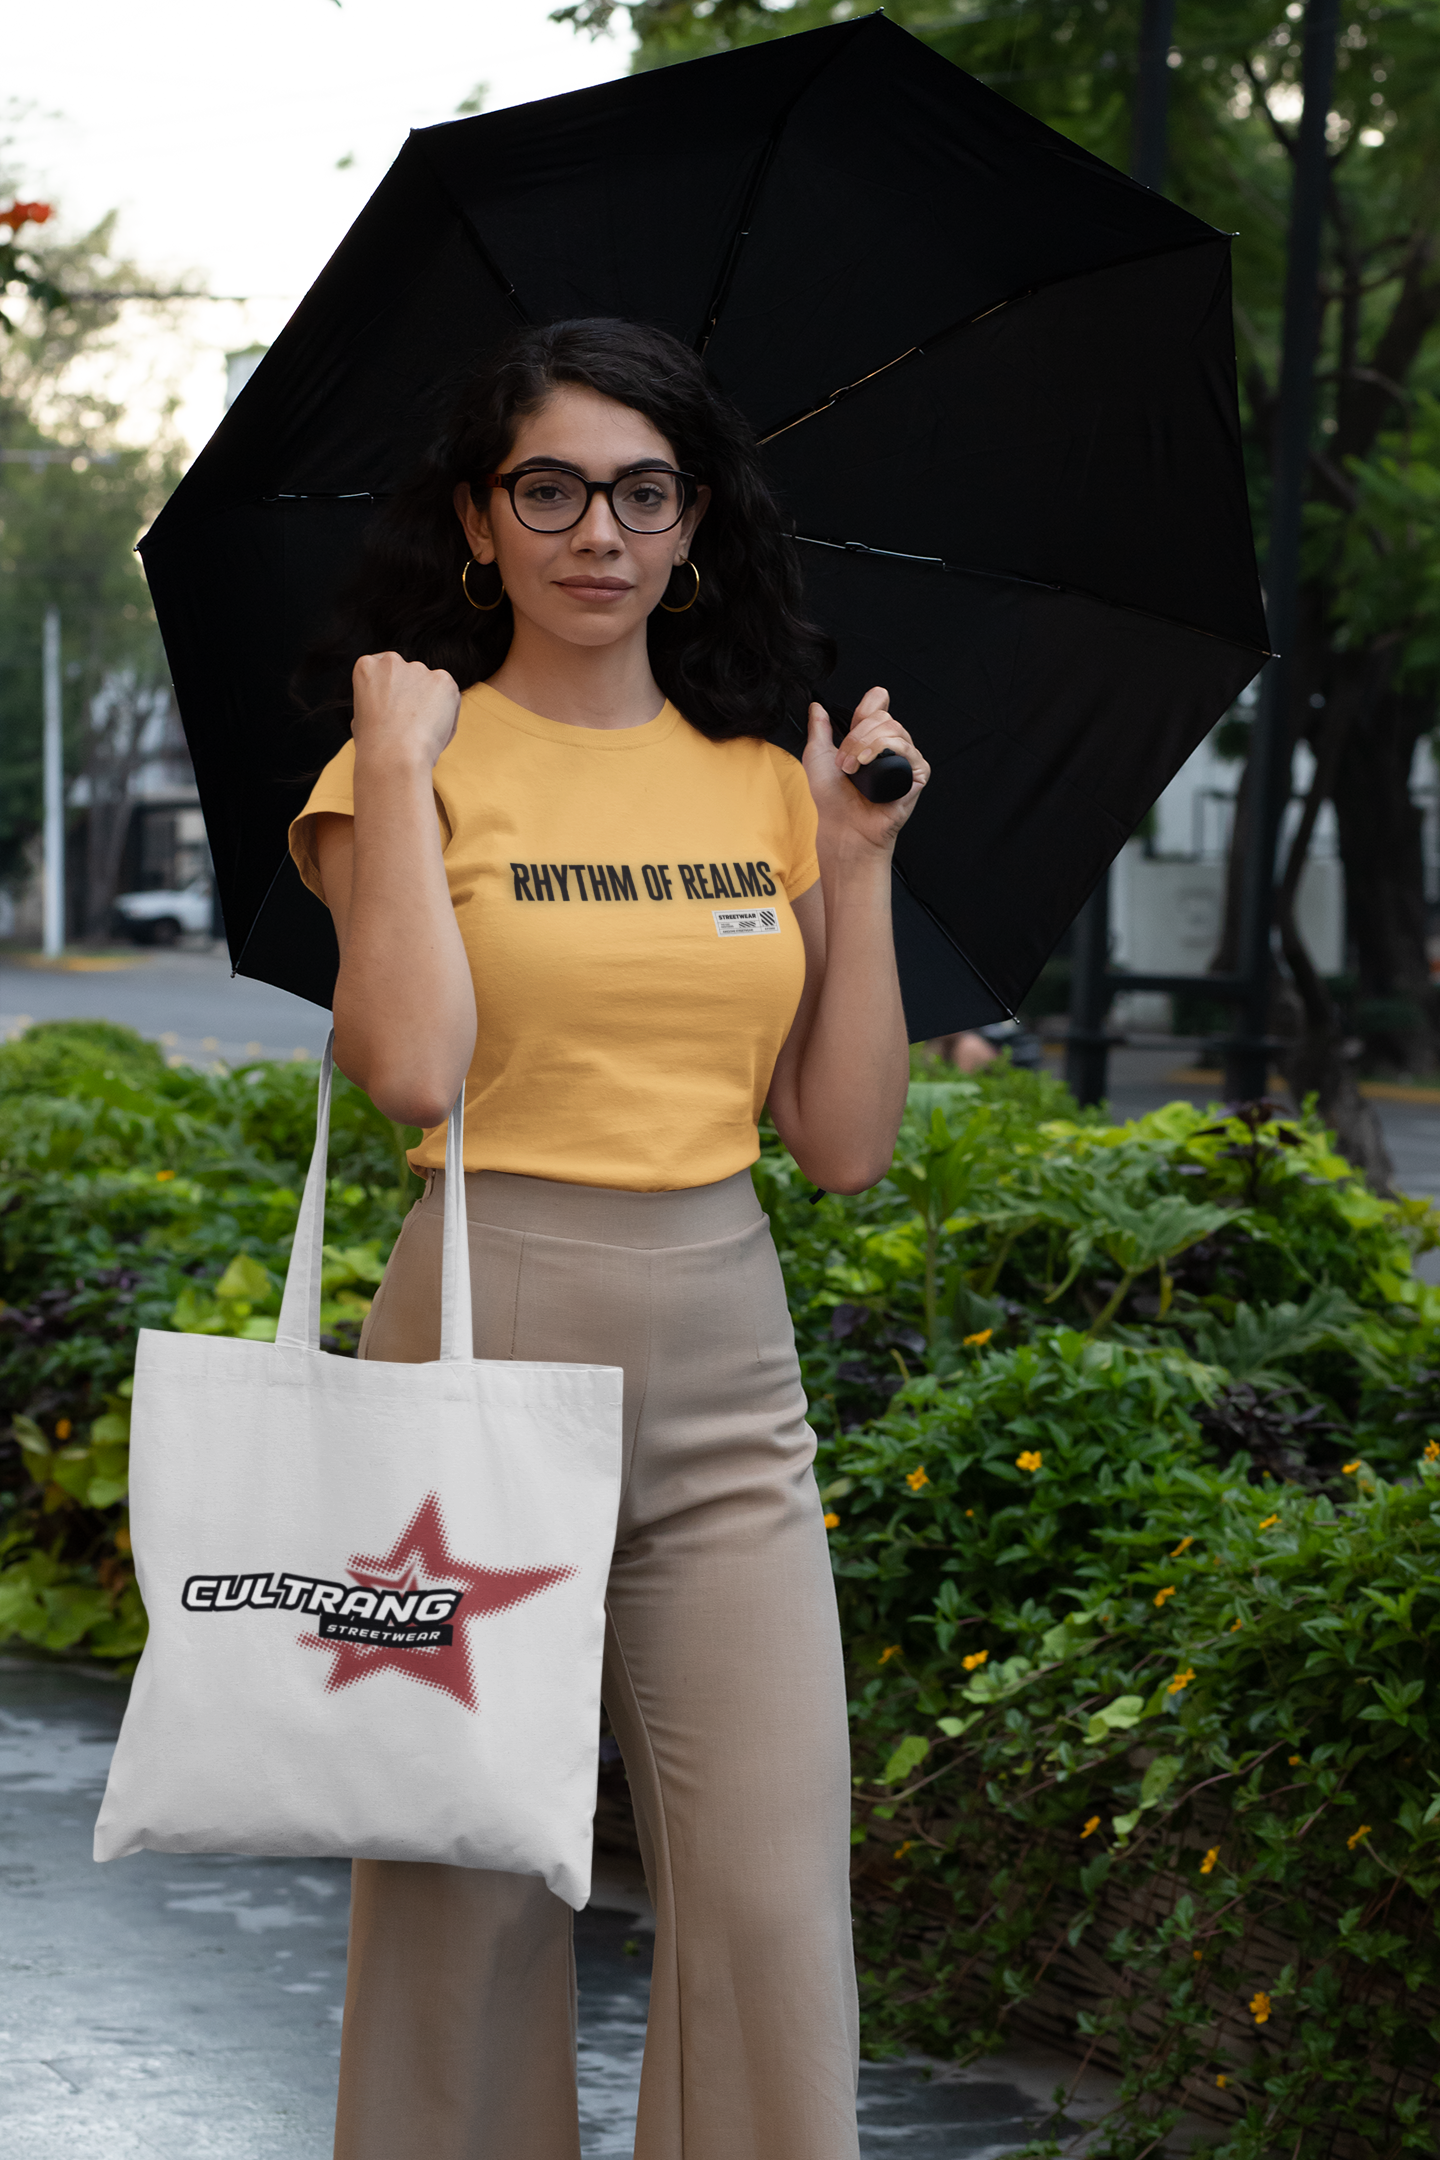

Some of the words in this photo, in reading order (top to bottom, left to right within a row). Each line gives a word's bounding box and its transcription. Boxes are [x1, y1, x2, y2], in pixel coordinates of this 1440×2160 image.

[510, 862, 639, 901] RHYTHM
[641, 864, 673, 901] OF
[677, 861, 777, 900] REALMS
[718, 913, 757, 921] STREETWEAR
[182, 1573, 463, 1626] CULTRANG
[326, 1623, 442, 1643] STREETWEAR
